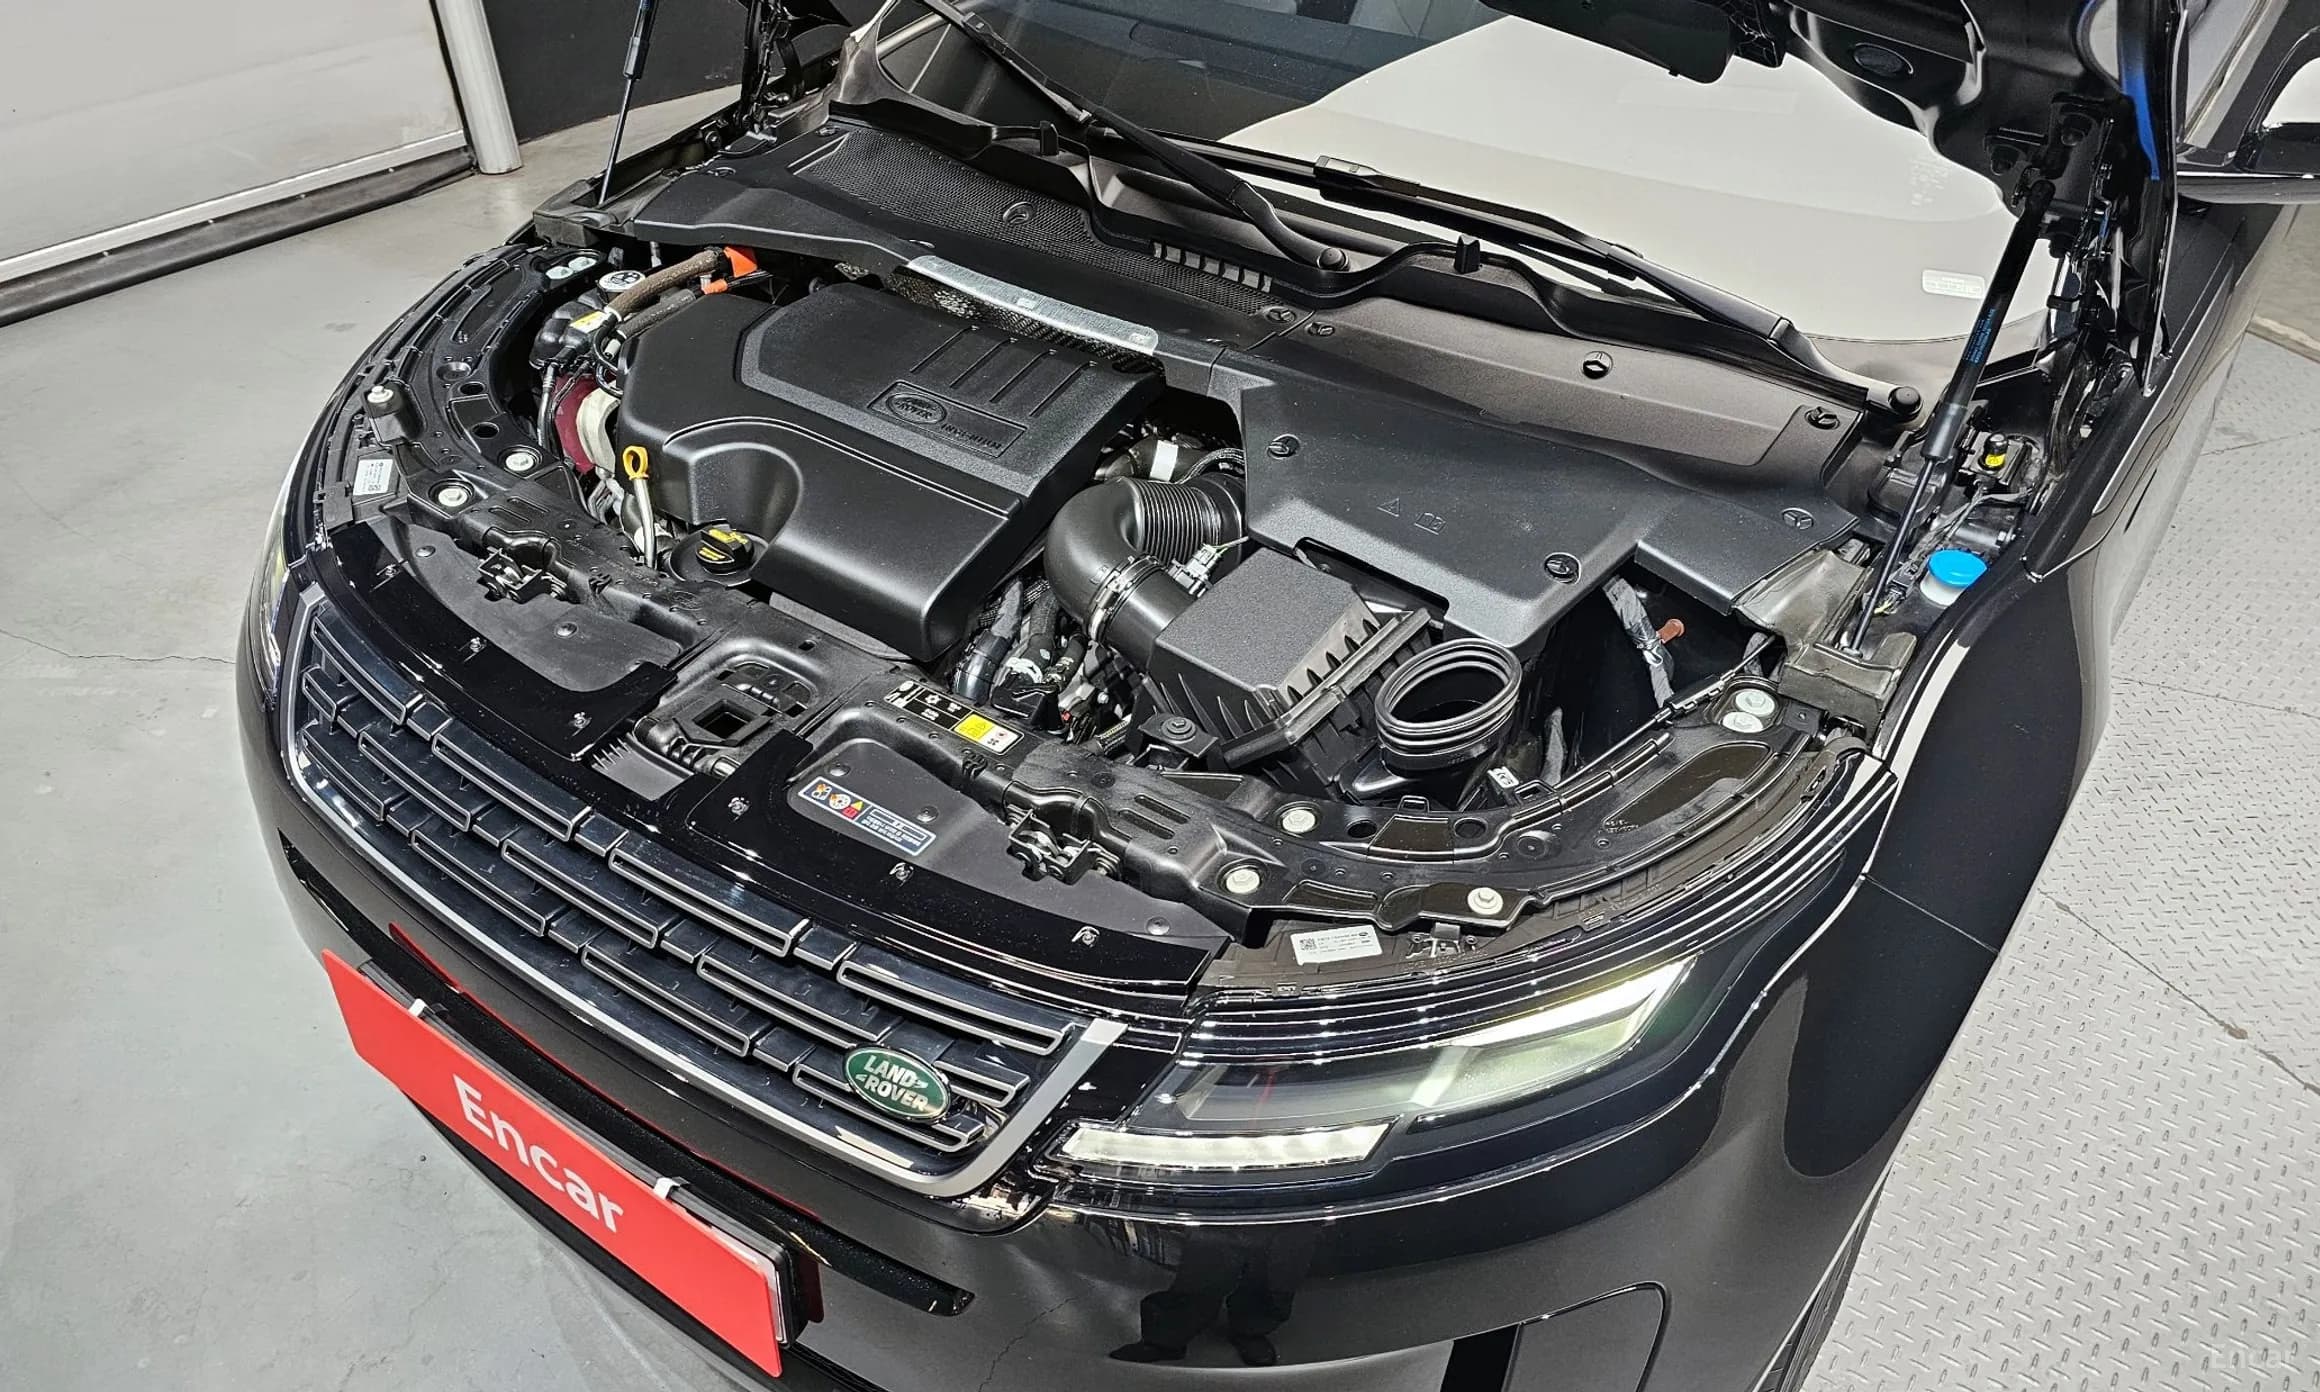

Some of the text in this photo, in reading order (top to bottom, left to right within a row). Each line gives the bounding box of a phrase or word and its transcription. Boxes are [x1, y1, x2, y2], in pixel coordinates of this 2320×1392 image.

[863, 1054, 918, 1088] LAND
[863, 1074, 929, 1112] ROVER
[452, 1073, 624, 1234] Encar
